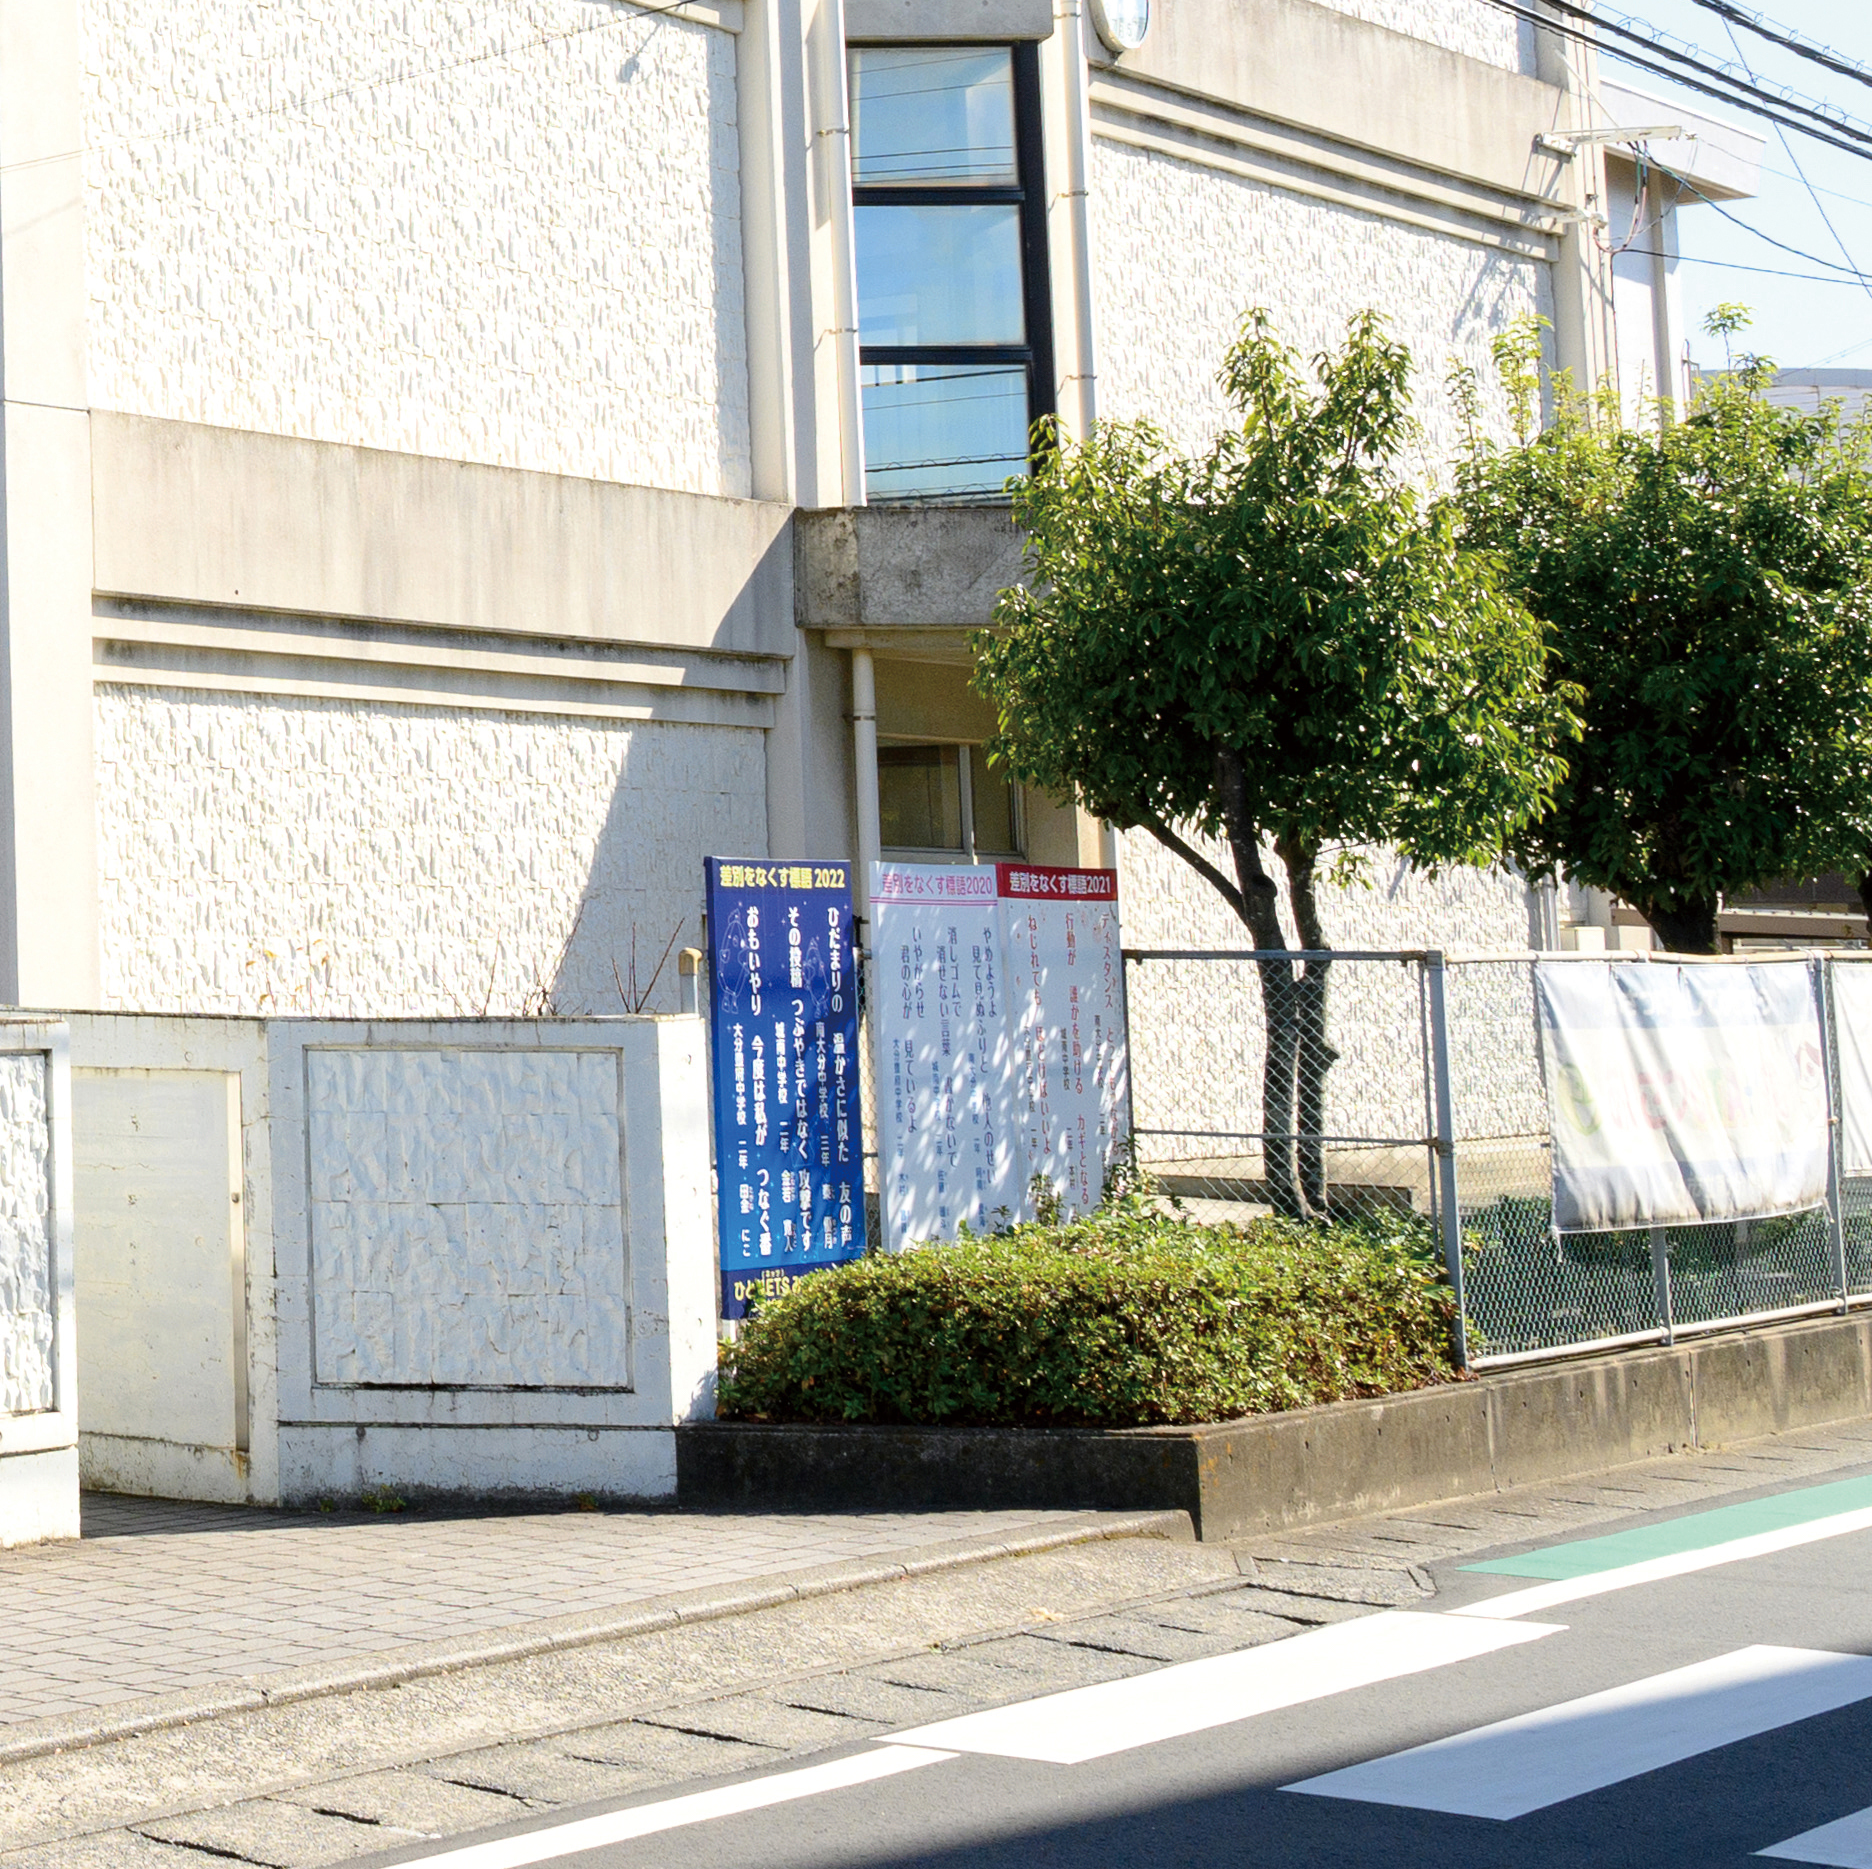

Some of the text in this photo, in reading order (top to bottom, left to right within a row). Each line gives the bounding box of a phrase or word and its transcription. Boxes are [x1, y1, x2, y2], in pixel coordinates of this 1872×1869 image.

[912, 926, 925, 1019] いやがらせ
[947, 926, 962, 1018] 消しゴムで
[971, 944, 988, 1074] 見て見ぬふりと
[983, 926, 998, 1018] やめようよ
[1027, 914, 1042, 1007] ねじれても
[1102, 912, 1113, 1009] ディスタンス
[732, 1022, 748, 1126] 大分豊府中学校
[746, 905, 773, 1256] おもいやり 今度は私が つなぐ番
[775, 1021, 789, 1105] 城南中学校
[788, 906, 813, 1252] その投稿 つぶやきではなく 攻撃です
[815, 1021, 829, 1119] 南大分中学校
[827, 906, 853, 1248] ひだまりの 温かさに似た 友の声
[900, 944, 918, 1134] 君の心が 見ているよ
[936, 944, 957, 1168] 消せない言葉 書かないで
[1065, 912, 1089, 1205] 行動が 誰かを助ける カギとなる
[738, 1140, 749, 1170] 二年
[779, 1121, 790, 1154] 二年
[820, 1135, 831, 1167] 三年
[741, 1228, 752, 1258] にこ
